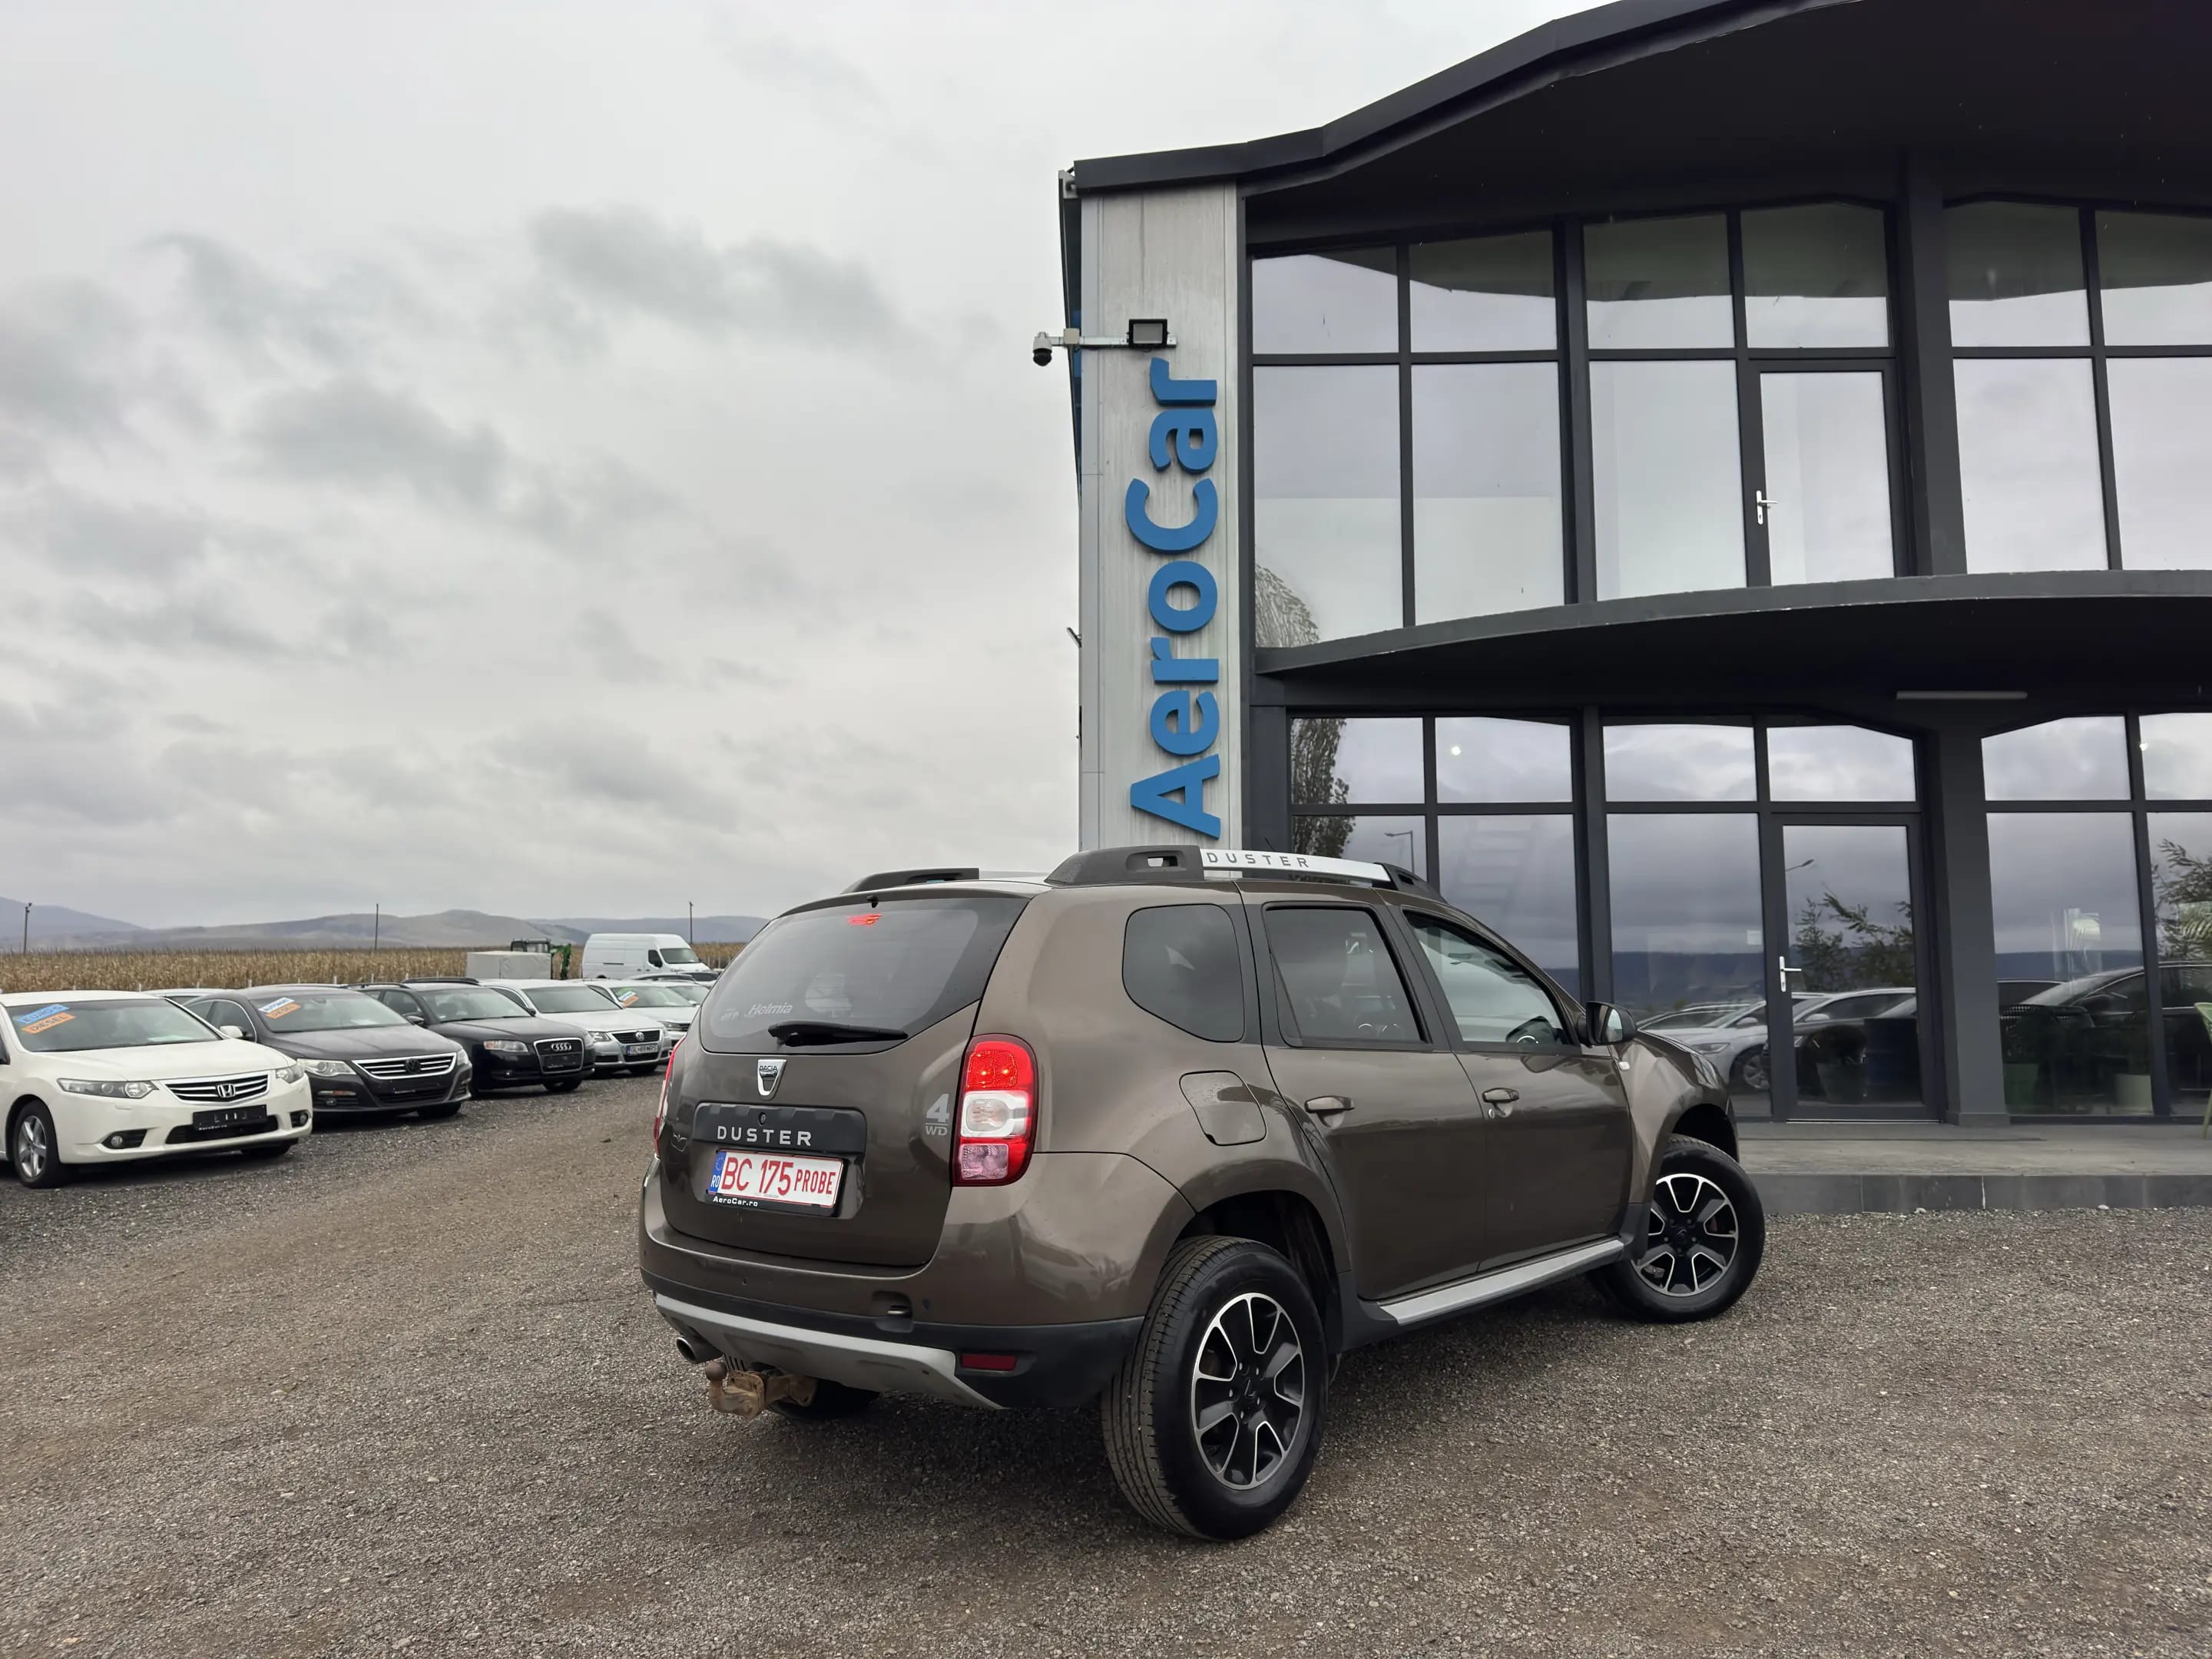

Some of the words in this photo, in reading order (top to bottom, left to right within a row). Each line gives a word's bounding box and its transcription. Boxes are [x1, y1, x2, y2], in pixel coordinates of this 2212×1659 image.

[1125, 356, 1221, 839] AeroCar
[1206, 852, 1310, 868] DUSTER
[30, 1014, 70, 1031] DIESEL
[926, 1093, 949, 1123] 4
[717, 1125, 812, 1147] DUSTER
[925, 1124, 948, 1136] WD
[710, 1174, 720, 1188] RO
[721, 1157, 753, 1191] BC
[758, 1159, 794, 1196] 175
[794, 1169, 836, 1195] PROBE
[713, 1195, 759, 1207] AeroCar.ro
